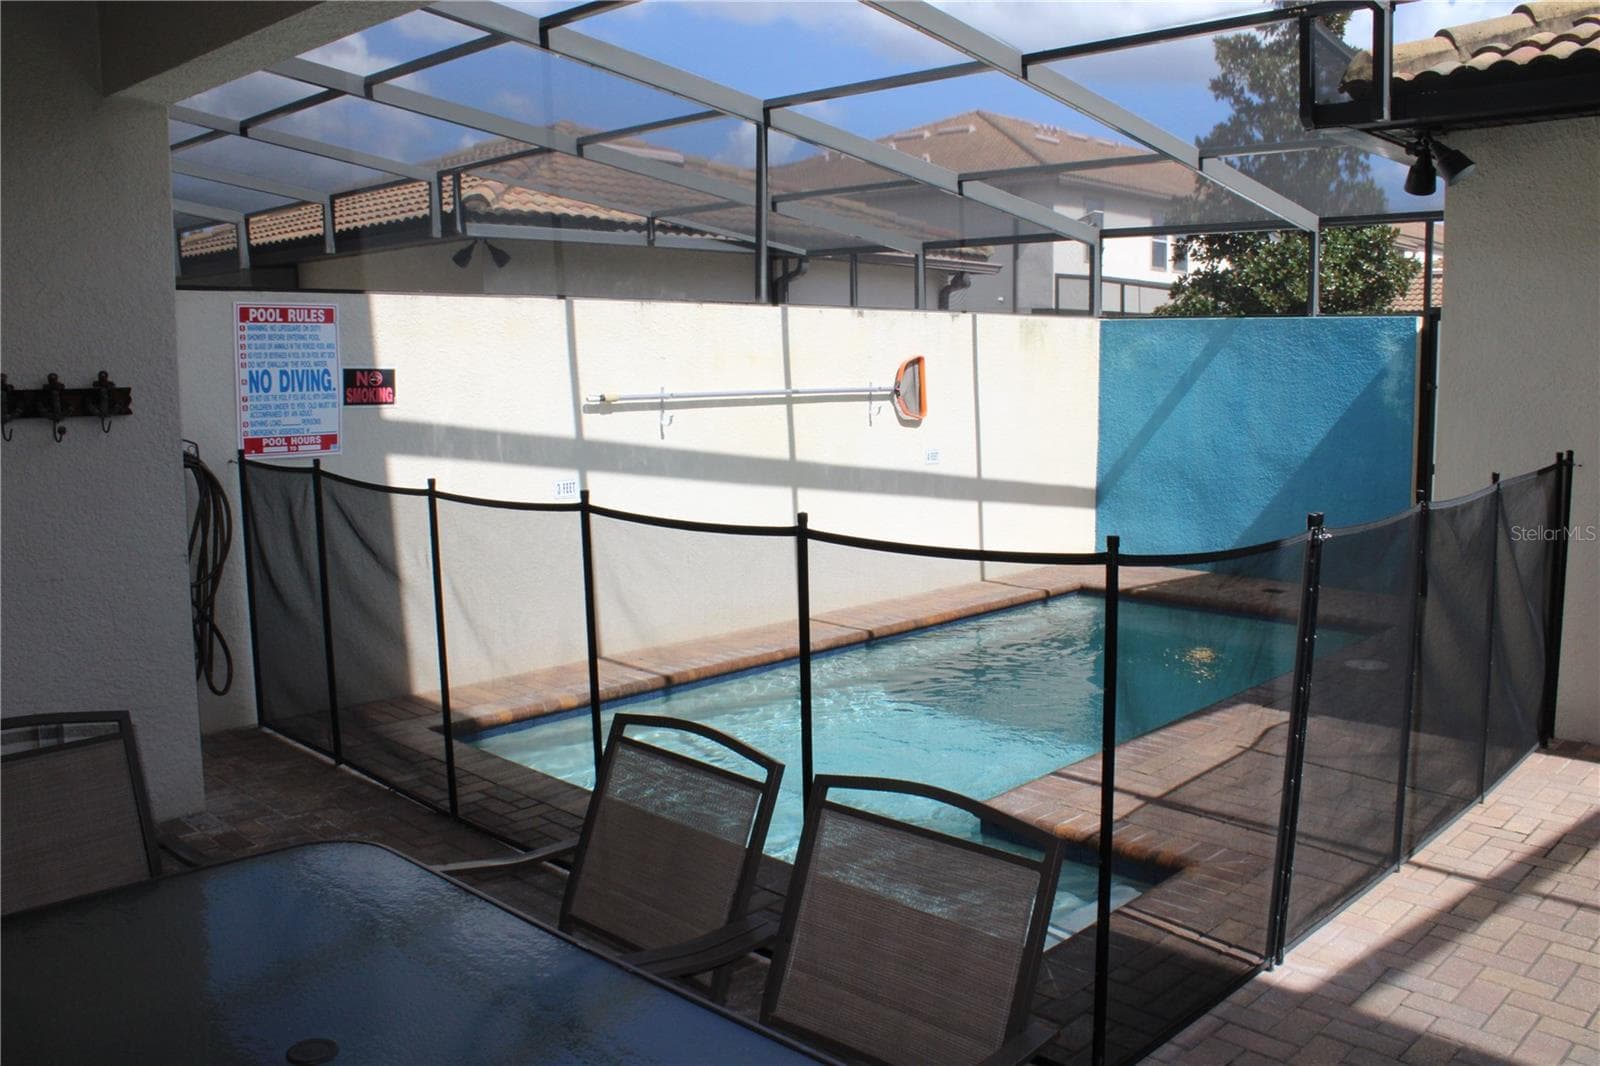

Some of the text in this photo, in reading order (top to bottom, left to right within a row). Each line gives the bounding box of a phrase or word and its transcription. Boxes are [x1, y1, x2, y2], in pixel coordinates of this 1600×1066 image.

[249, 308, 325, 322] POOL RULES
[249, 368, 336, 393] NO DIVING.
[346, 387, 393, 403] SMOKING
[262, 436, 321, 446] POOL HOURS
[563, 482, 576, 494] FEET
